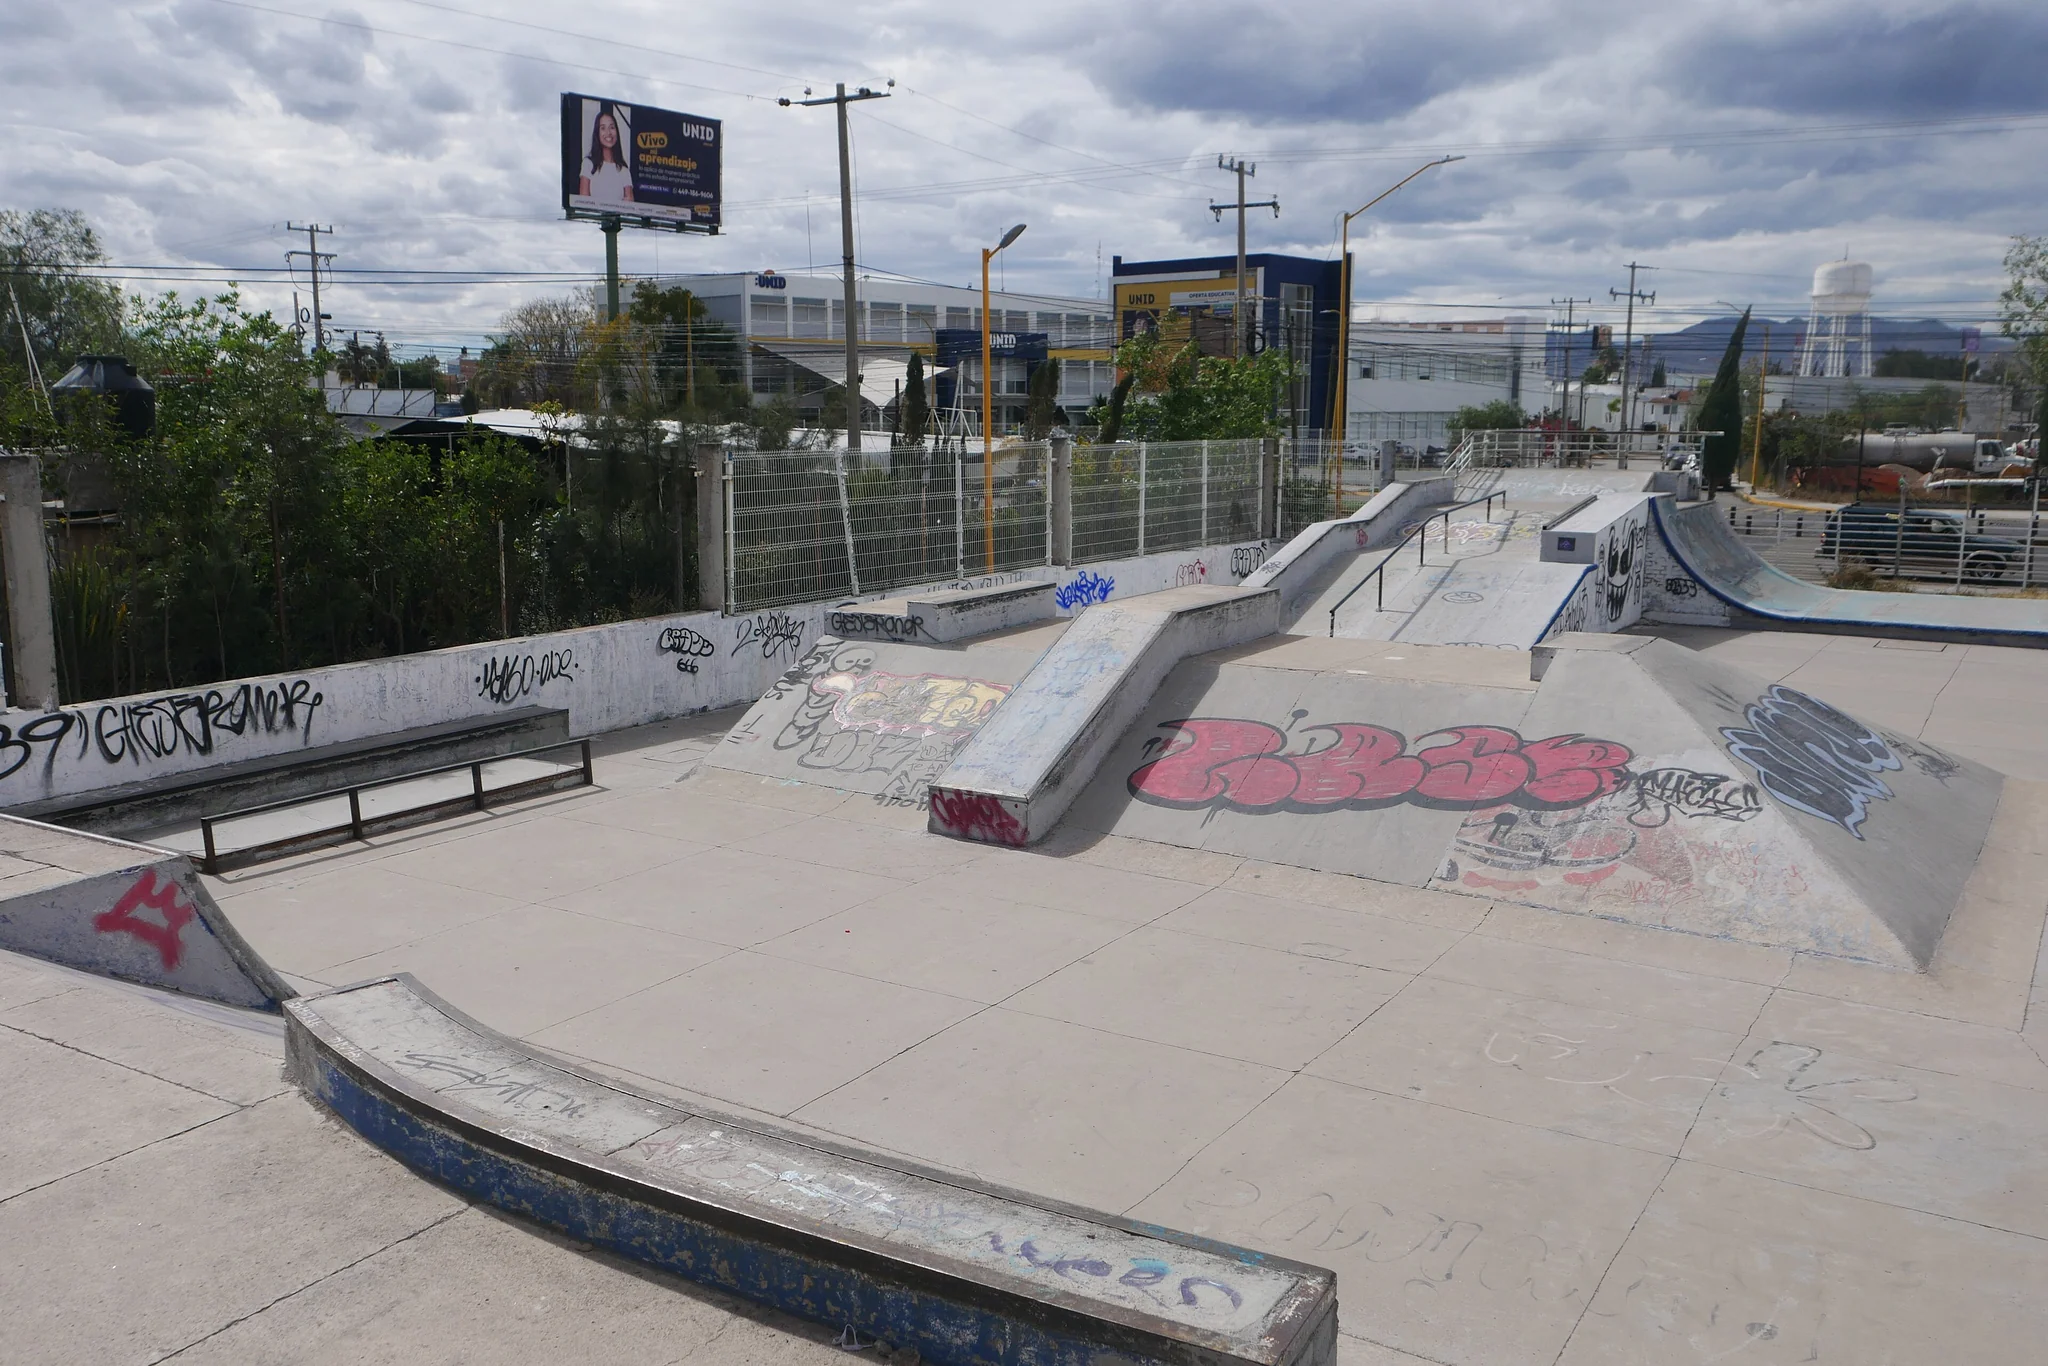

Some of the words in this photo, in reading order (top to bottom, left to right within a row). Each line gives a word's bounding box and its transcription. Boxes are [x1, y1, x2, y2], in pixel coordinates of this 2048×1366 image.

[682, 122, 714, 141] UNID
[640, 134, 665, 146] Vivo
[639, 152, 697, 171] aprendizaje
[758, 274, 787, 289] UNID
[1128, 293, 1155, 305] UNID
[989, 333, 1016, 348] UNID
[676, 657, 699, 674] 666
